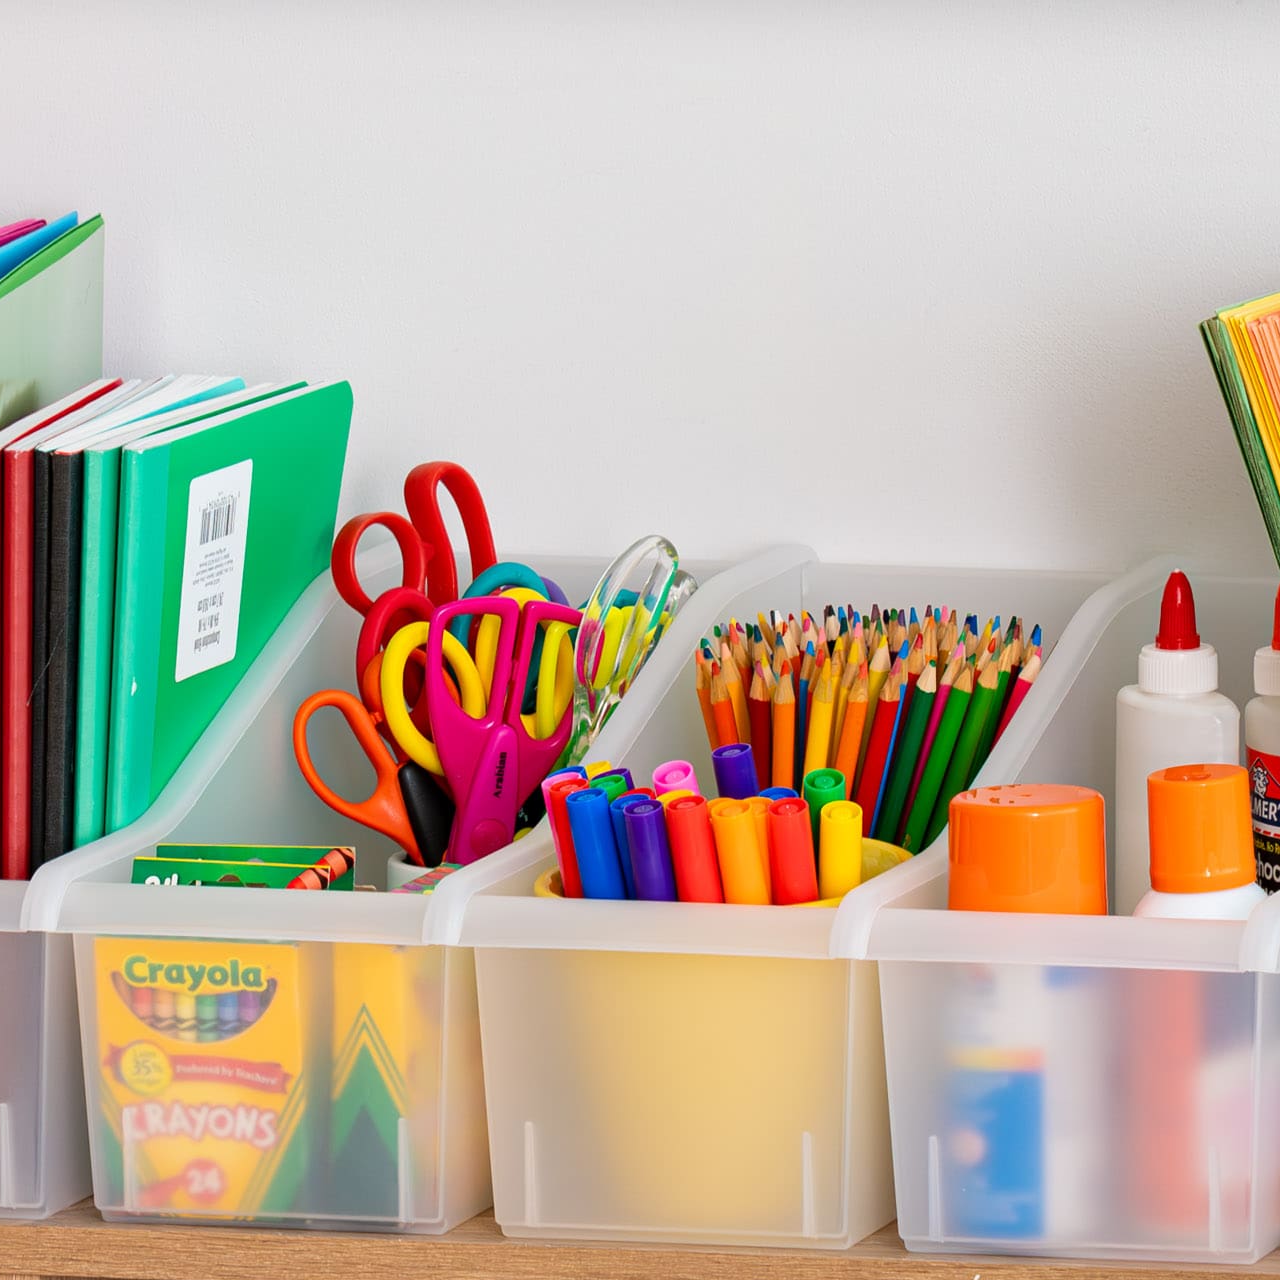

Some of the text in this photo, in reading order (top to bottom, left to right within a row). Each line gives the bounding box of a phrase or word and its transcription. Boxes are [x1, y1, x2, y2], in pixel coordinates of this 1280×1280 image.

[125, 955, 263, 992] Crayola
[122, 1101, 278, 1149] CRAYONS
[187, 1166, 220, 1194] 24
